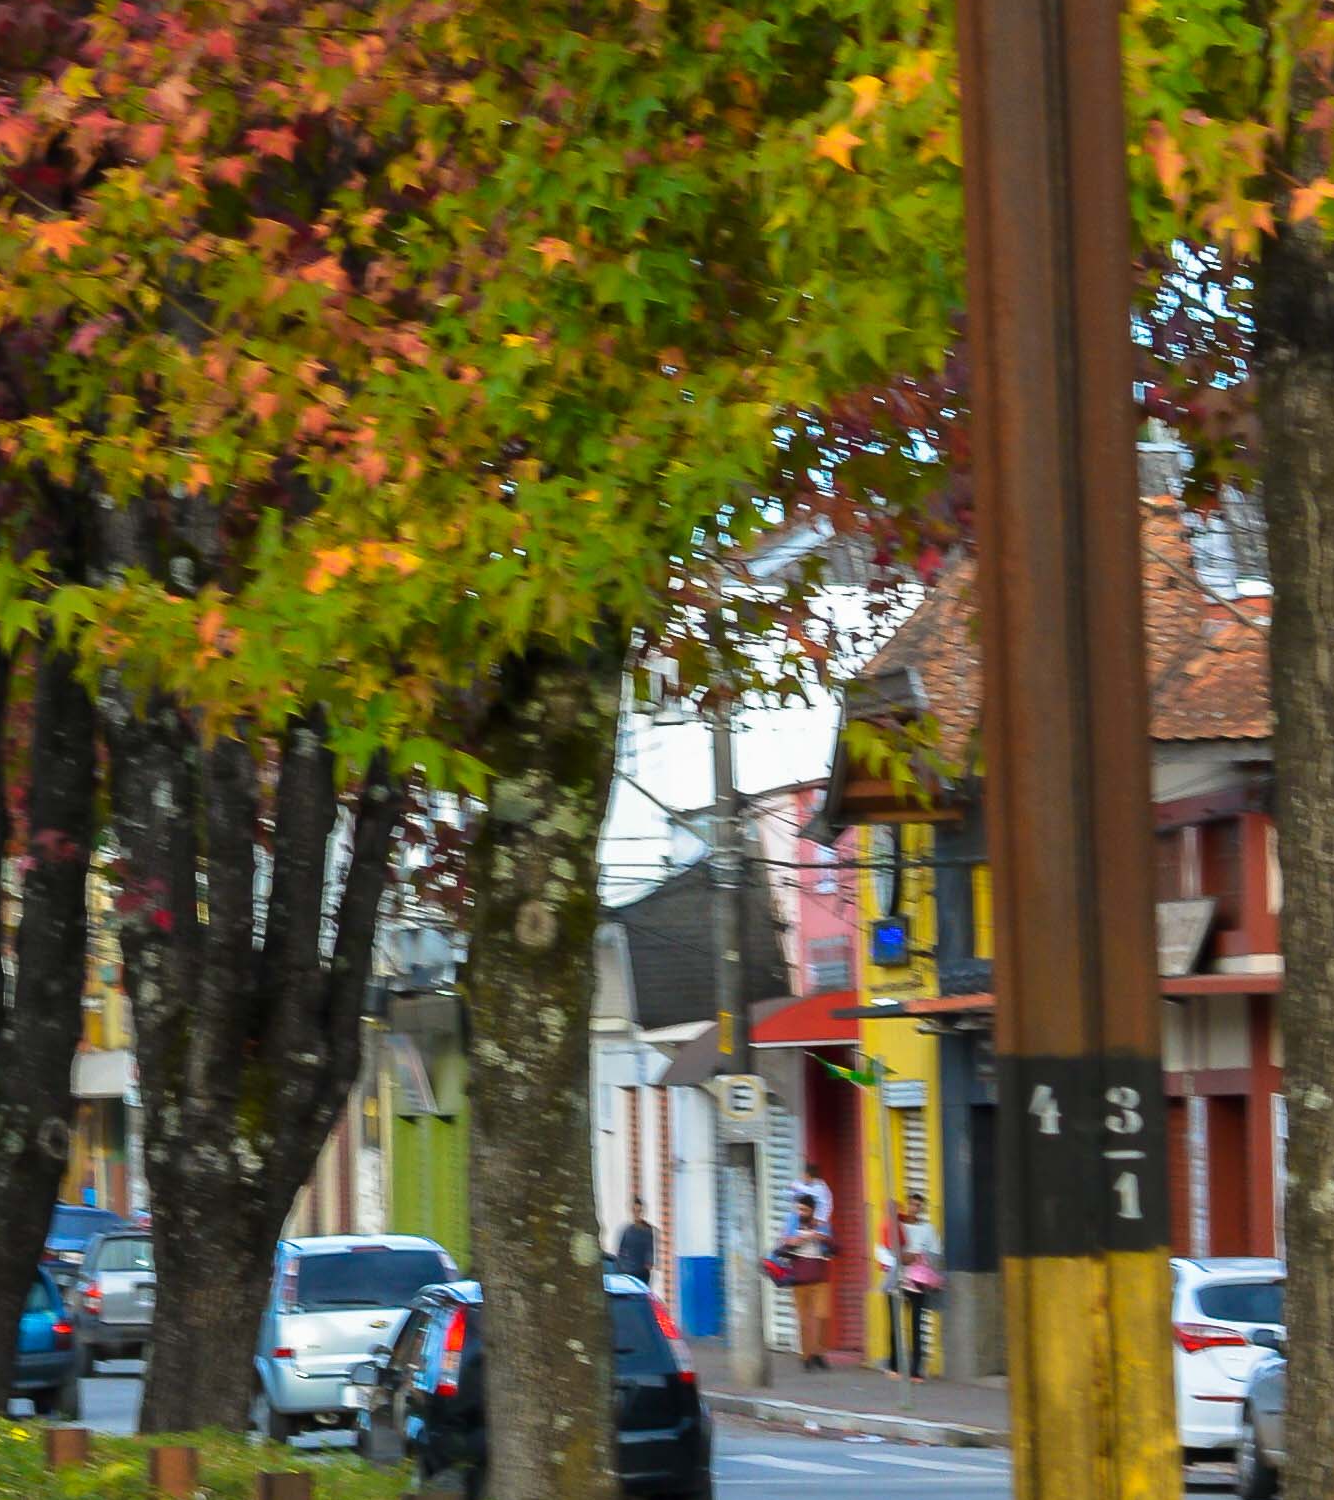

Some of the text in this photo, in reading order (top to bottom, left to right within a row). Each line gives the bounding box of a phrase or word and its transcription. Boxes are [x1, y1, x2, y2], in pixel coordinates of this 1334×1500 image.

[1028, 1084, 1144, 1134] 4 3
[1113, 1171, 1144, 1219] 1
